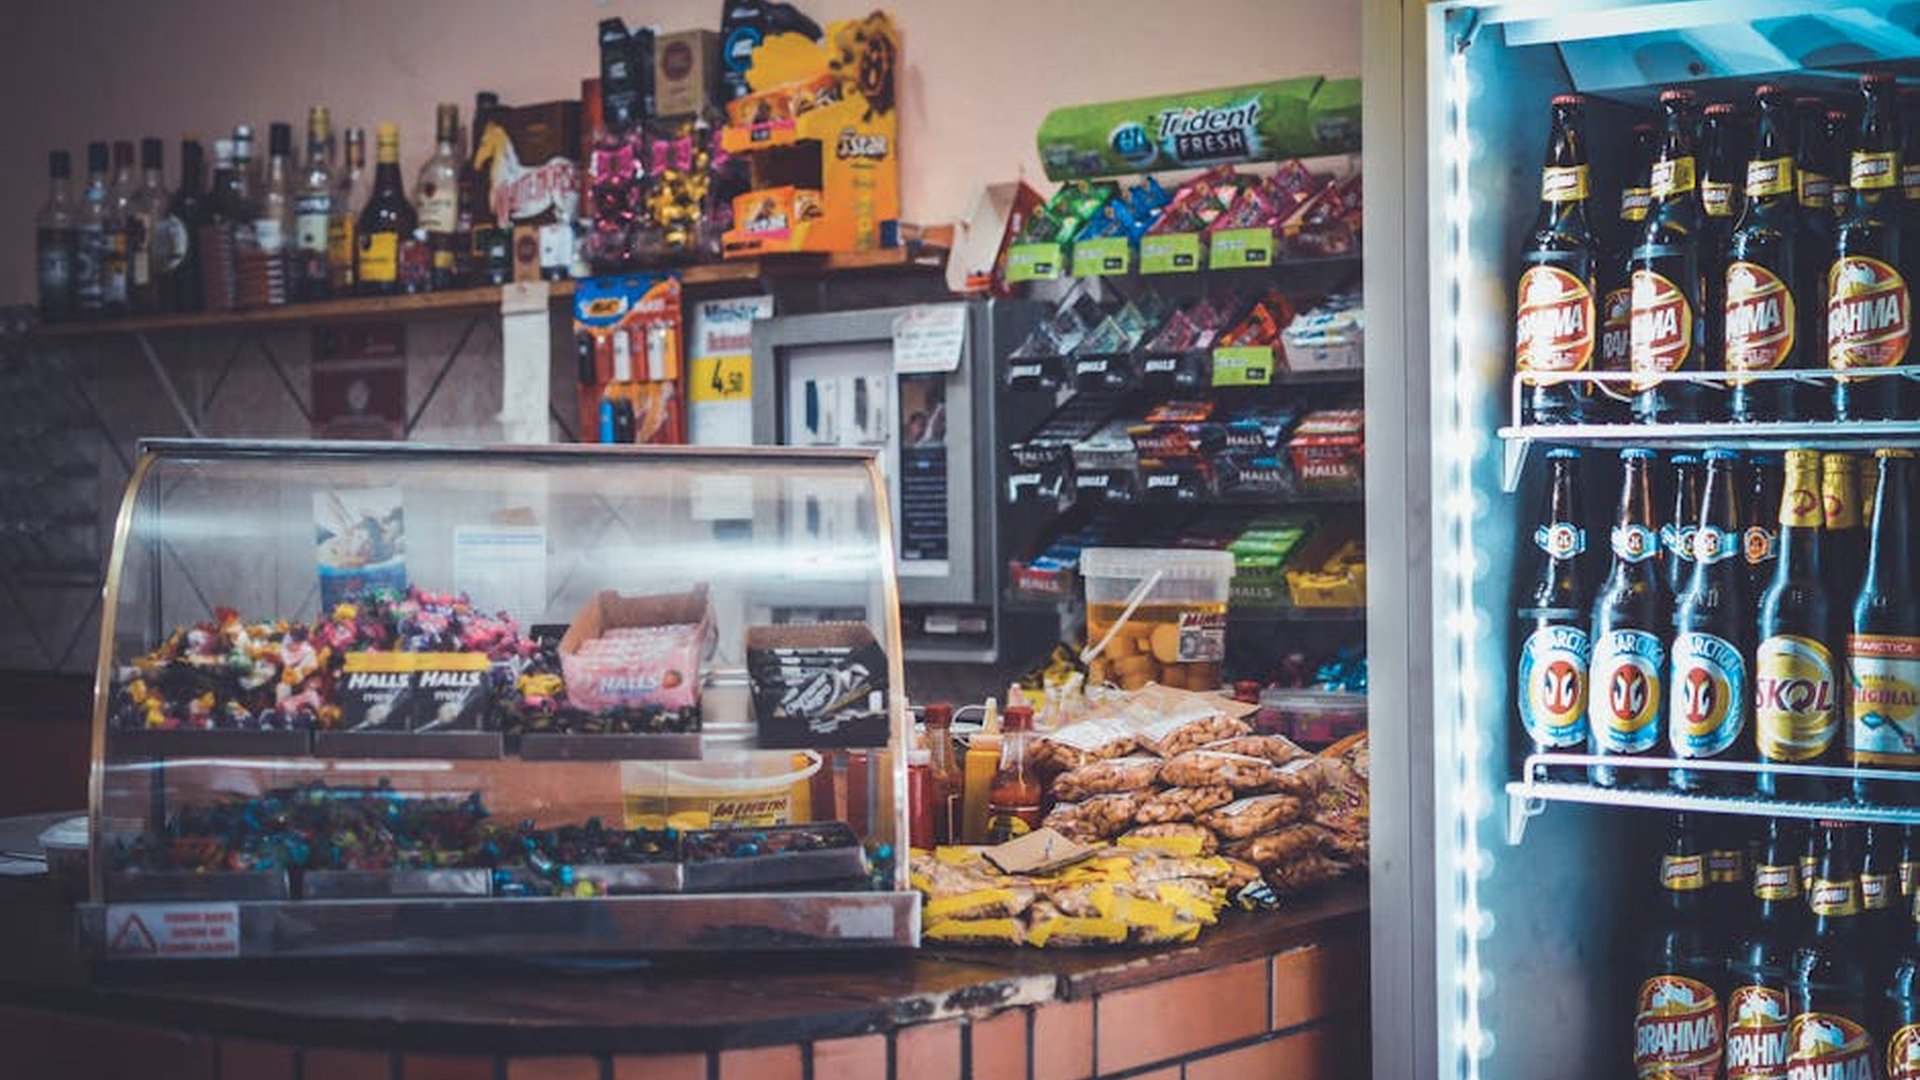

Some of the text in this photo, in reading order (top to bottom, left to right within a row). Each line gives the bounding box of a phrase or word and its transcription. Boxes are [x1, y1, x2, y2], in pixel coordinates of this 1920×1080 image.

[1158, 101, 1259, 139] Trident
[1178, 130, 1242, 153] FRESH
[1227, 434, 1263, 446] HALLS
[1239, 469, 1281, 482] HALLS
[1302, 464, 1349, 479] HALLS
[347, 672, 410, 690] HALLS
[420, 670, 482, 688] HALLS
[600, 676, 659, 694] HALLS
[1754, 678, 1833, 715] SKOL
[1636, 1012, 1719, 1058] BRAHMA
[1727, 1031, 1788, 1070] BRAHM
